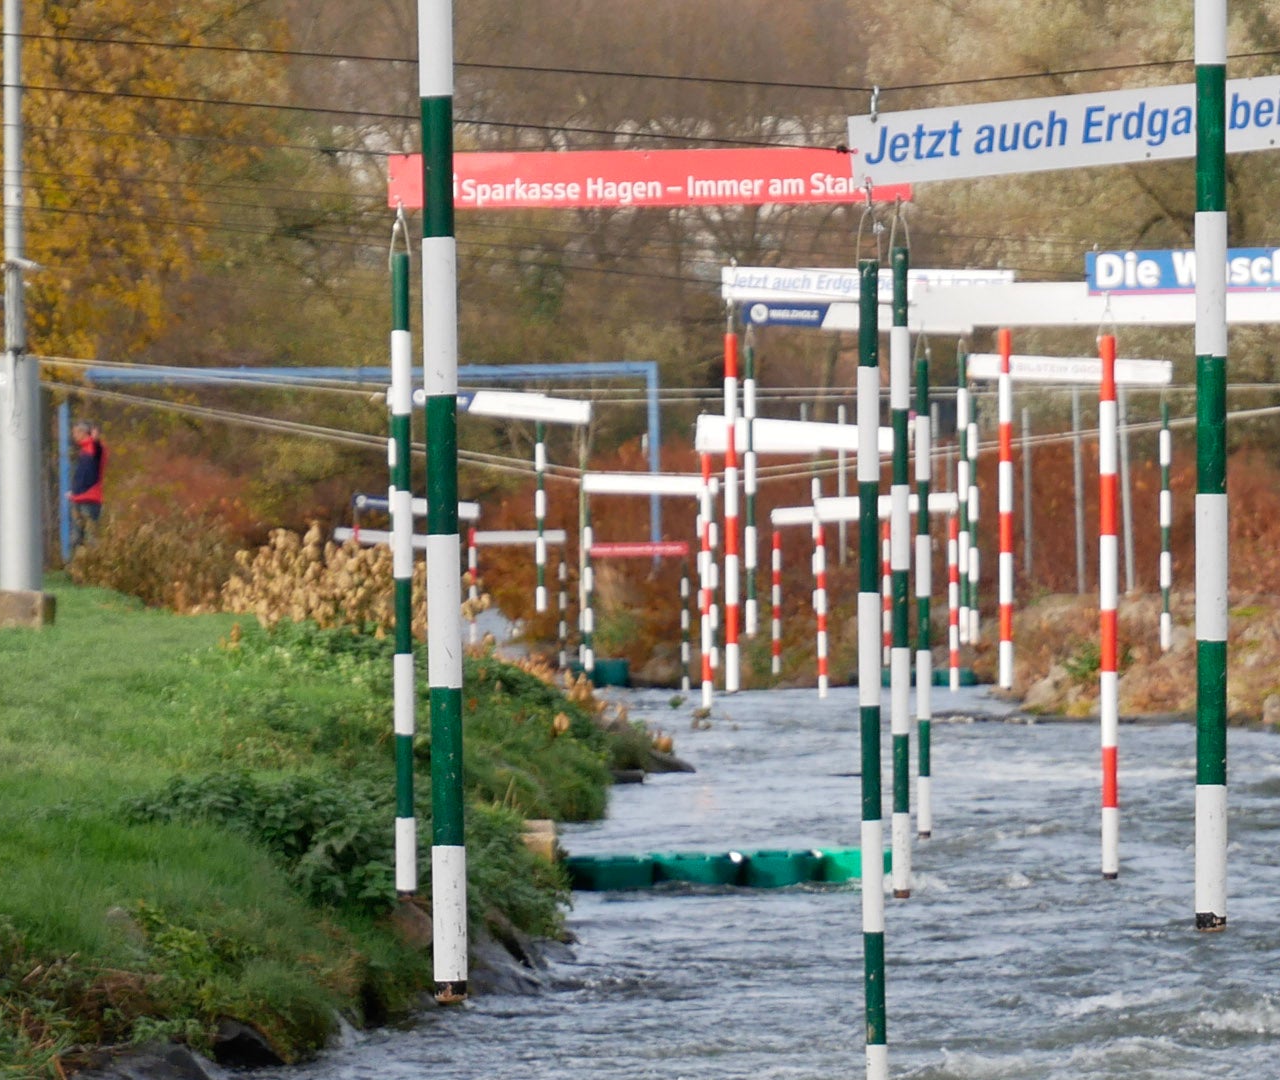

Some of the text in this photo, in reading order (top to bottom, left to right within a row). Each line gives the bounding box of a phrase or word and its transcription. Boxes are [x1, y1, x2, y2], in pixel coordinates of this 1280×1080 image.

[865, 119, 963, 166] Jetzt
[973, 110, 1068, 155] auch
[1081, 101, 1194, 147] Erdga
[461, 178, 581, 205] Sparkasse
[586, 177, 663, 203] Hagen
[686, 175, 764, 198] Immer
[768, 177, 805, 196] am
[809, 171, 867, 196] Star
[730, 273, 769, 288] Jetzt
[772, 274, 811, 290] auch
[816, 275, 860, 293] Erdga
[1095, 251, 1161, 289] Die
